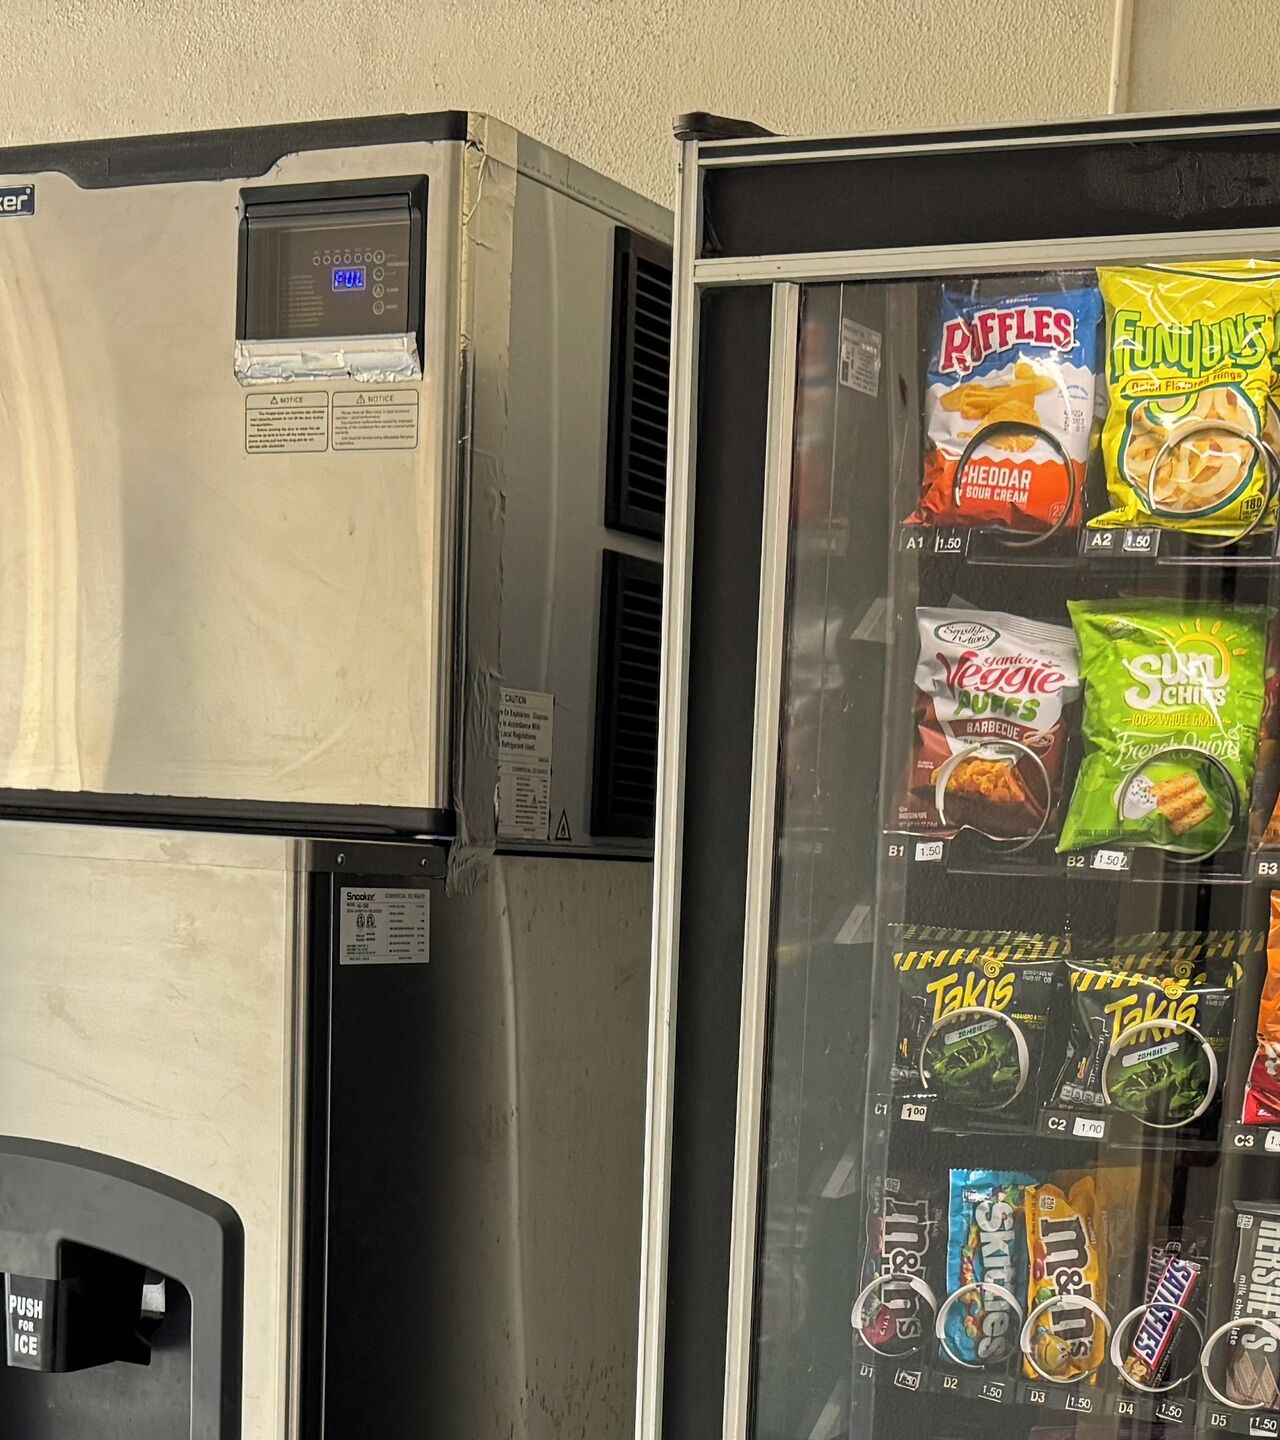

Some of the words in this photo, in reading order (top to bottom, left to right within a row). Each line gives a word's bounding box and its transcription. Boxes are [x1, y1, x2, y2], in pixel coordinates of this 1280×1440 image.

[280, 396, 303, 404] NOTICE
[368, 394, 394, 402] NOTICE
[960, 465, 1031, 488] CHEDDAR
[966, 488, 992, 499] SOUR
[994, 489, 1028, 504] CREAM
[1244, 498, 1261, 510] 180
[1091, 532, 1112, 546] A2
[936, 651, 1065, 699] Veggie
[1124, 653, 1230, 709] Sun
[1158, 714, 1191, 727] WHOLE
[967, 722, 1021, 740] BARBECUE
[888, 845, 904, 857] B1
[919, 845, 941, 857] 1.50
[1067, 856, 1085, 868] B2
[1258, 863, 1278, 875] B3
[1104, 990, 1199, 1048] Takis
[1048, 1117, 1067, 1130] C2
[1234, 1134, 1254, 1147] C3
[1238, 1274, 1246, 1295] milk
[9, 1294, 43, 1319] PUSH
[18, 1319, 34, 1332] FOR
[14, 1333, 38, 1356] ICE
[943, 1376, 958, 1389] D2
[982, 1384, 1002, 1398] 1.50
[1031, 1389, 1046, 1403] D3
[1070, 1396, 1091, 1409] 1.50
[1119, 1402, 1134, 1415] D4
[1160, 1403, 1182, 1418] 1.50
[1211, 1413, 1227, 1427] D5
[1254, 1417, 1277, 1431] 1.50
